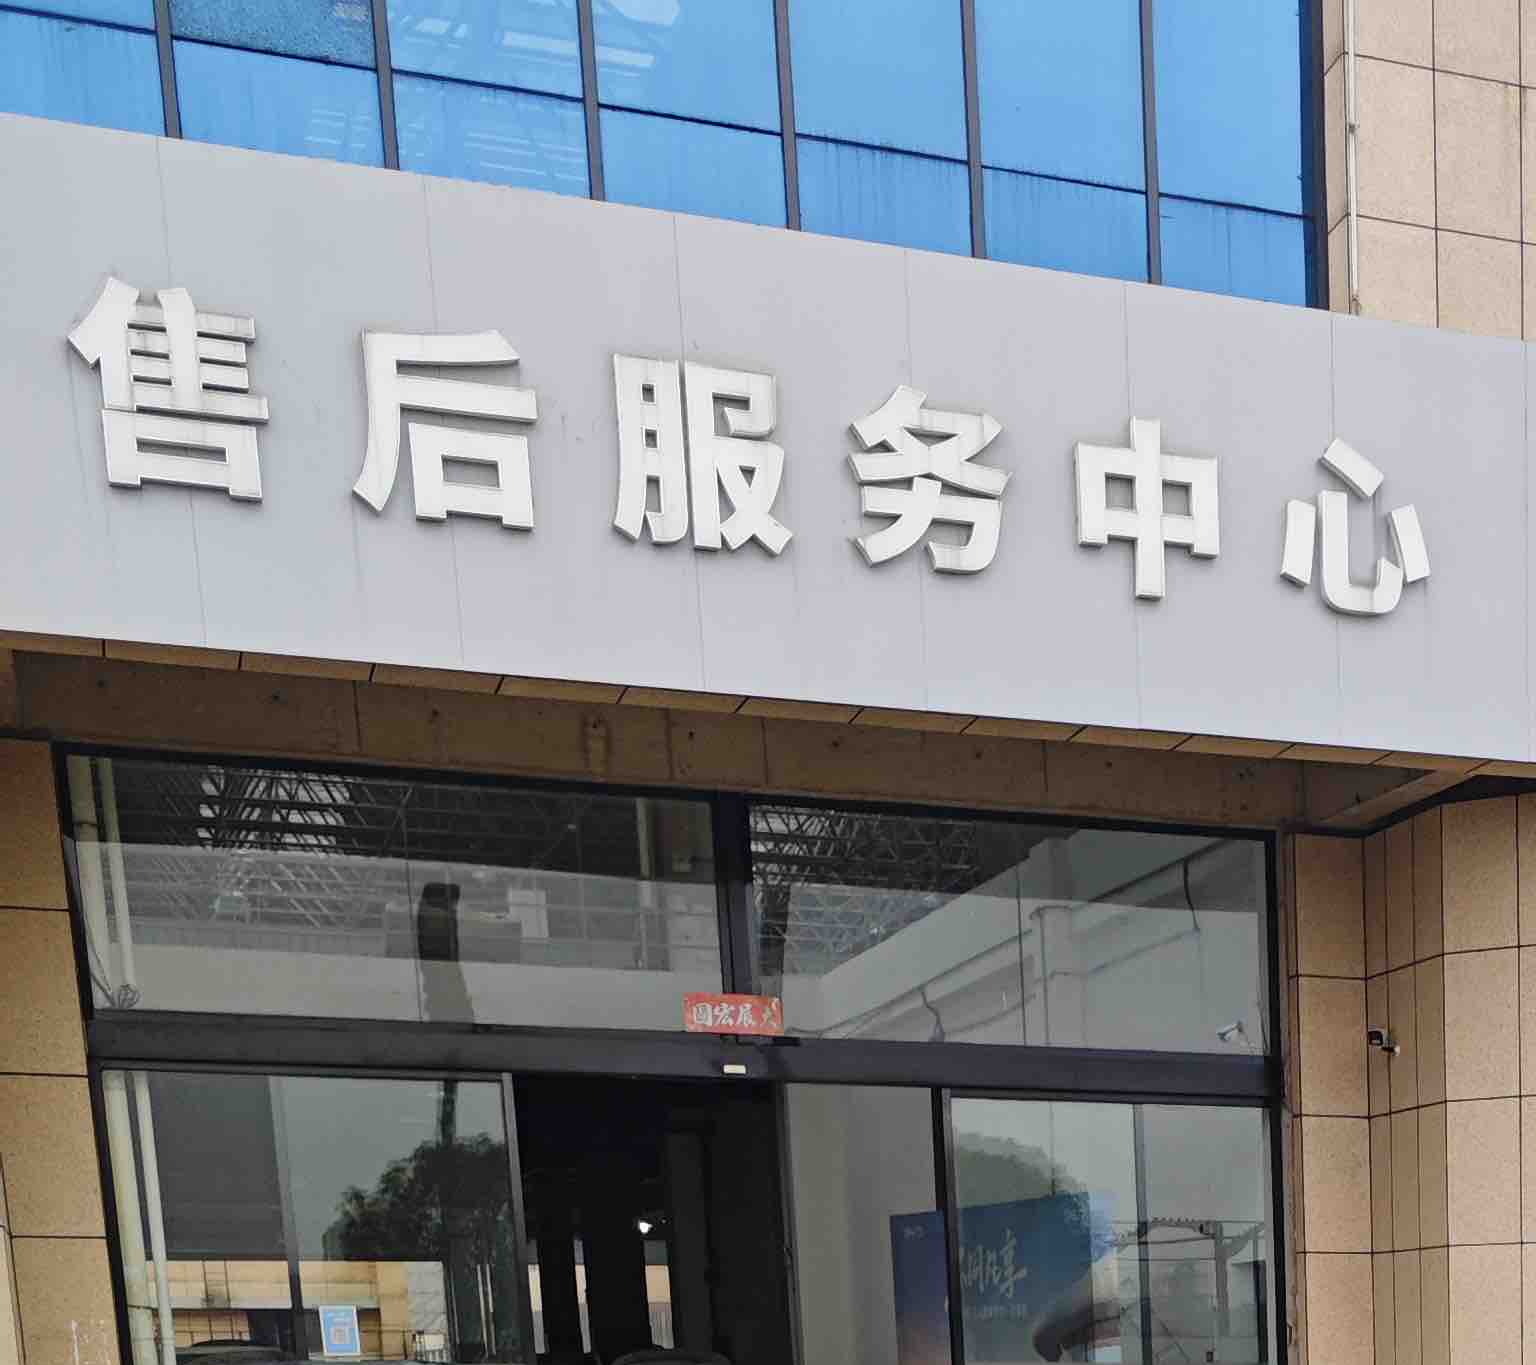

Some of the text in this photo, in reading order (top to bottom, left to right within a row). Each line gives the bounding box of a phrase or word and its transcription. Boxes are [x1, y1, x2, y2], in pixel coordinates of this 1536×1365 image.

[66, 276, 1431, 616] 售后服务中心
